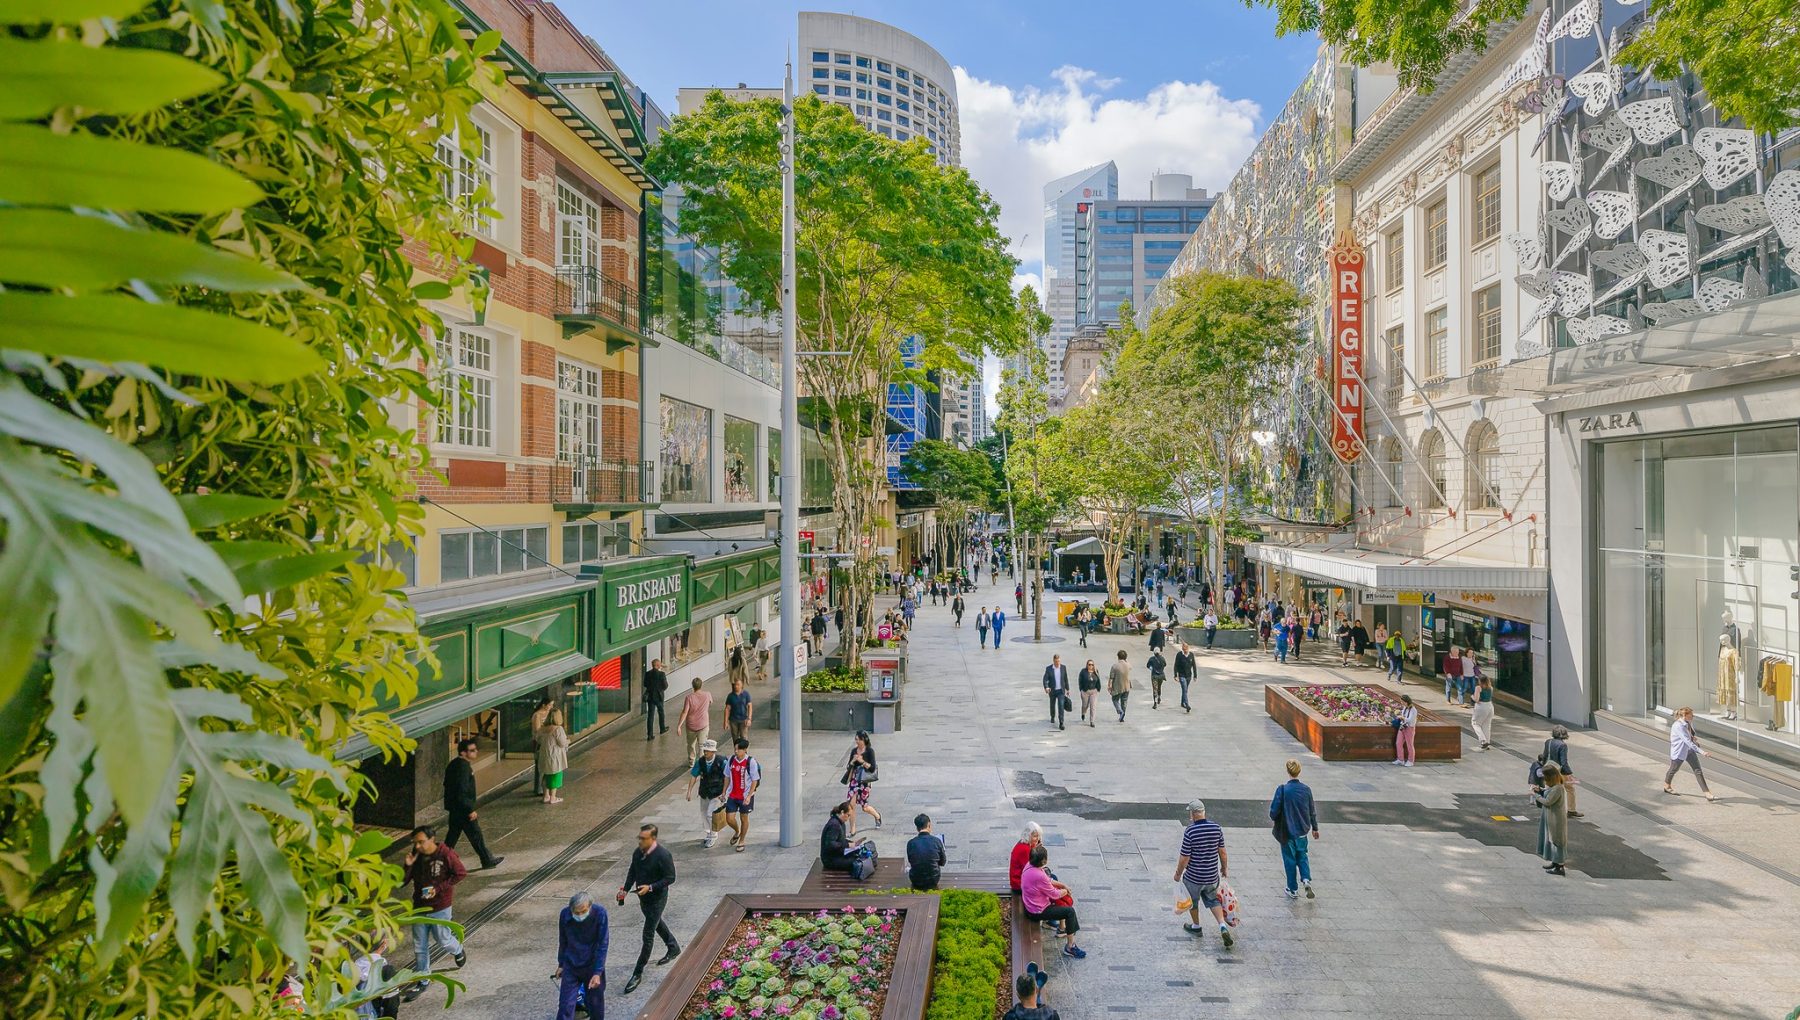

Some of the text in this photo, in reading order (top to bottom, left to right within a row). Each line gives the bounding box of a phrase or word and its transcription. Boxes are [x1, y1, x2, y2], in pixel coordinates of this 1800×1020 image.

[1340, 270, 1359, 436] REGENT
[1579, 411, 1642, 432] ZARA
[616, 574, 682, 608] BRISBANE
[623, 598, 677, 632] ARCADE
